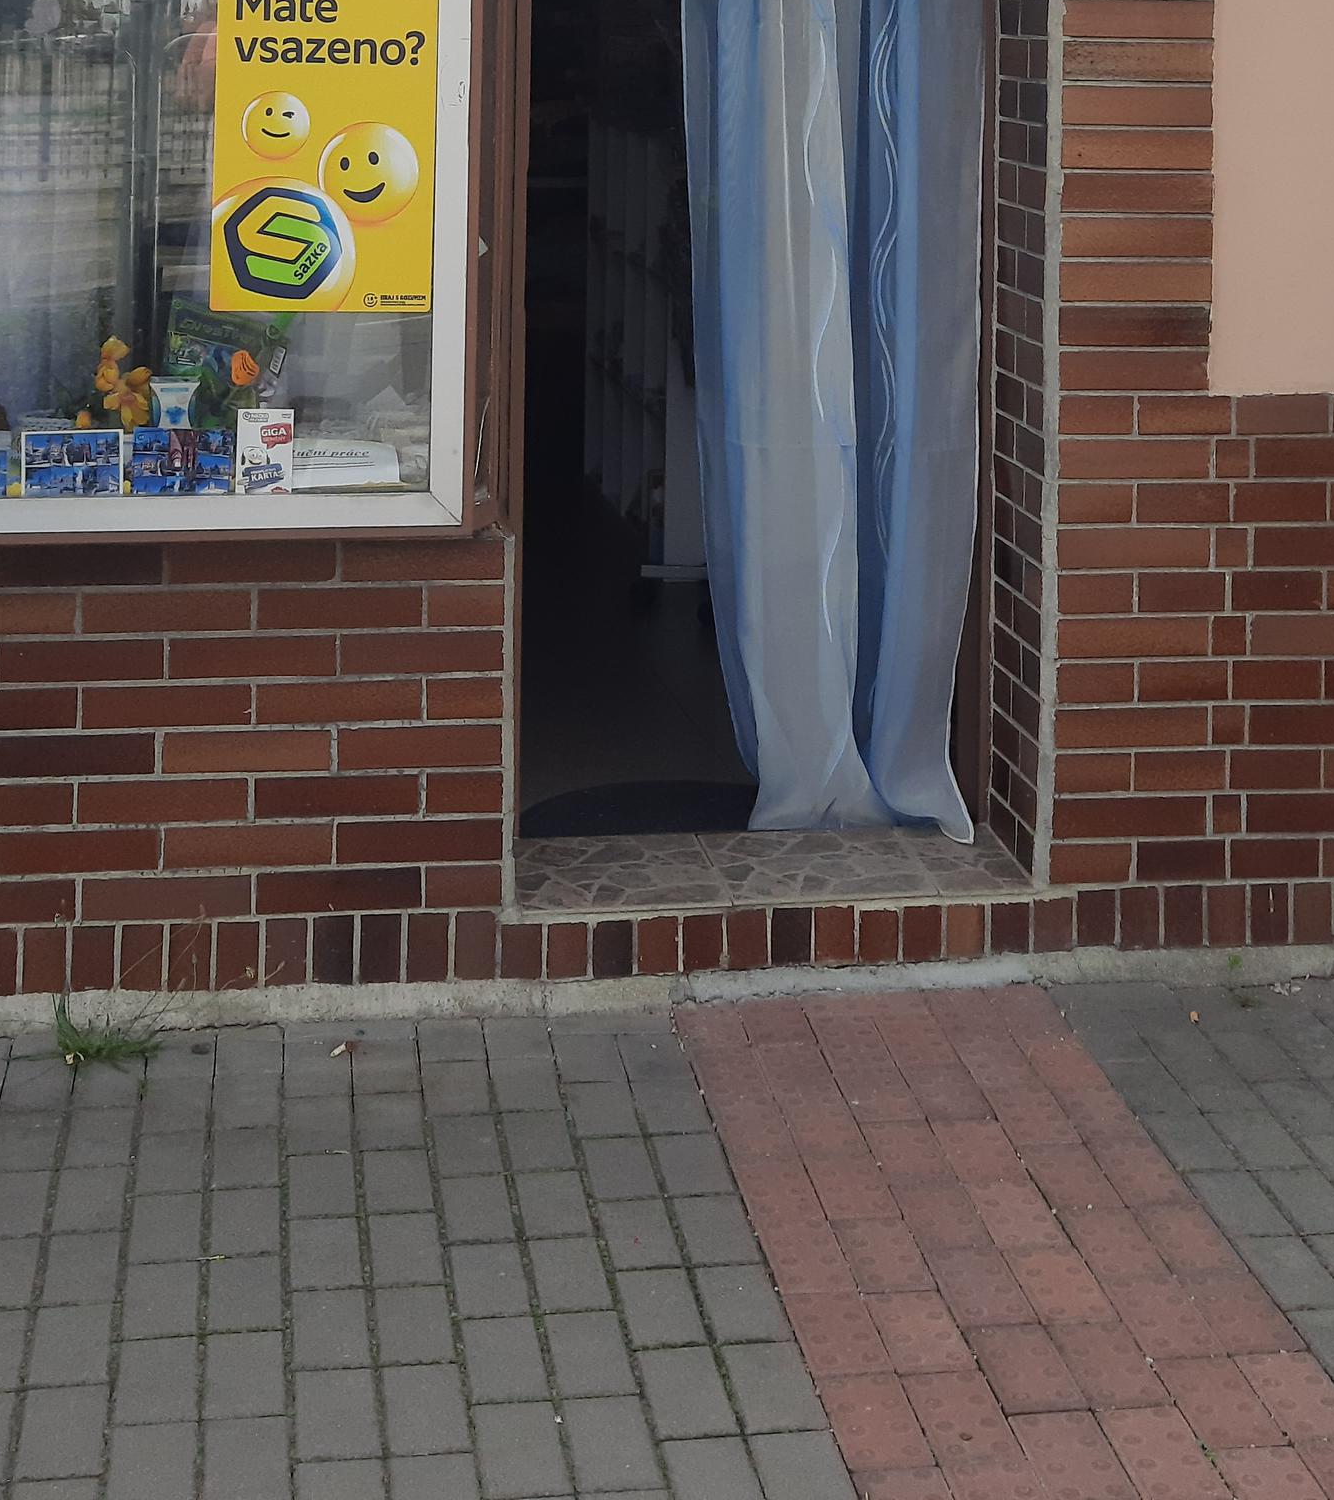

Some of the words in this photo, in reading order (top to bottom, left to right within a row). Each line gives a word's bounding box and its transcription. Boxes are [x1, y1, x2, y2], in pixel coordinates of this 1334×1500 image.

[235, 30, 426, 66] vsazeno?
[293, 240, 328, 281] sazka
[261, 428, 287, 437] GIGA
